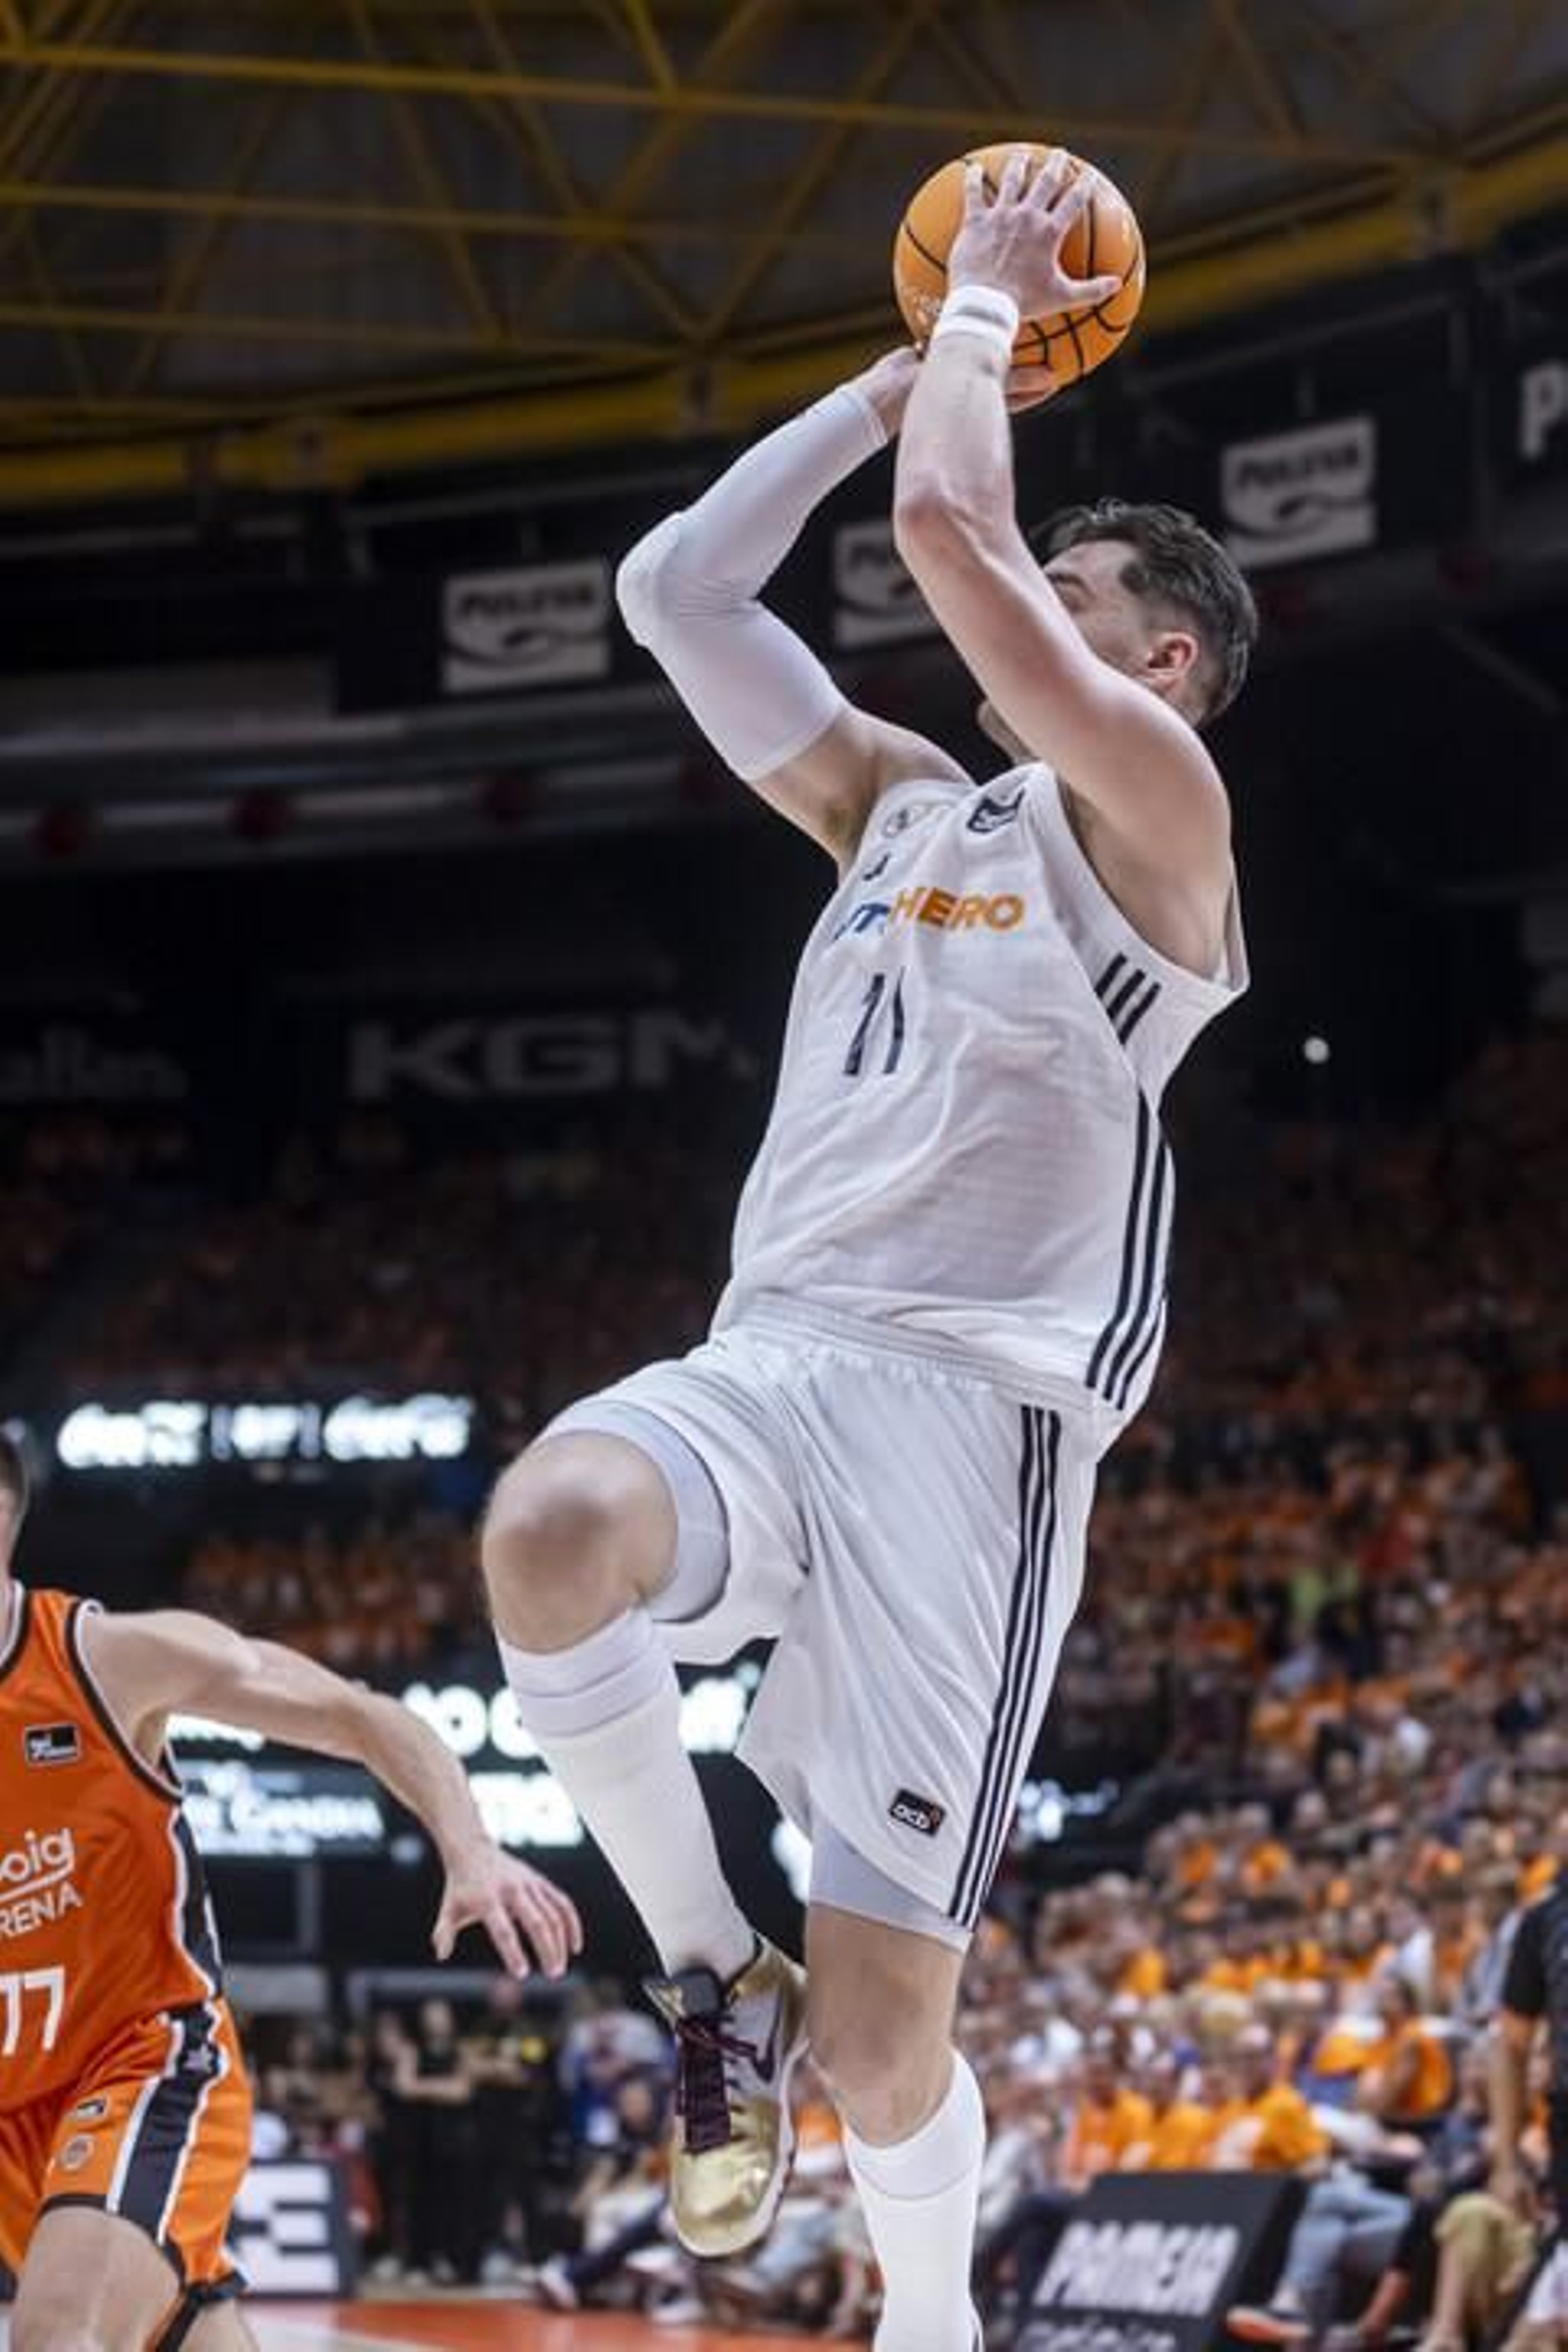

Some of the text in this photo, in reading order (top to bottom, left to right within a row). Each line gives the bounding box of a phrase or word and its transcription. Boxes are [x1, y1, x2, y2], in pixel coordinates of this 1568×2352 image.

[0, 1828, 75, 1884] oig
[0, 1882, 84, 1938] RENA
[0, 1965, 66, 2055] 77
